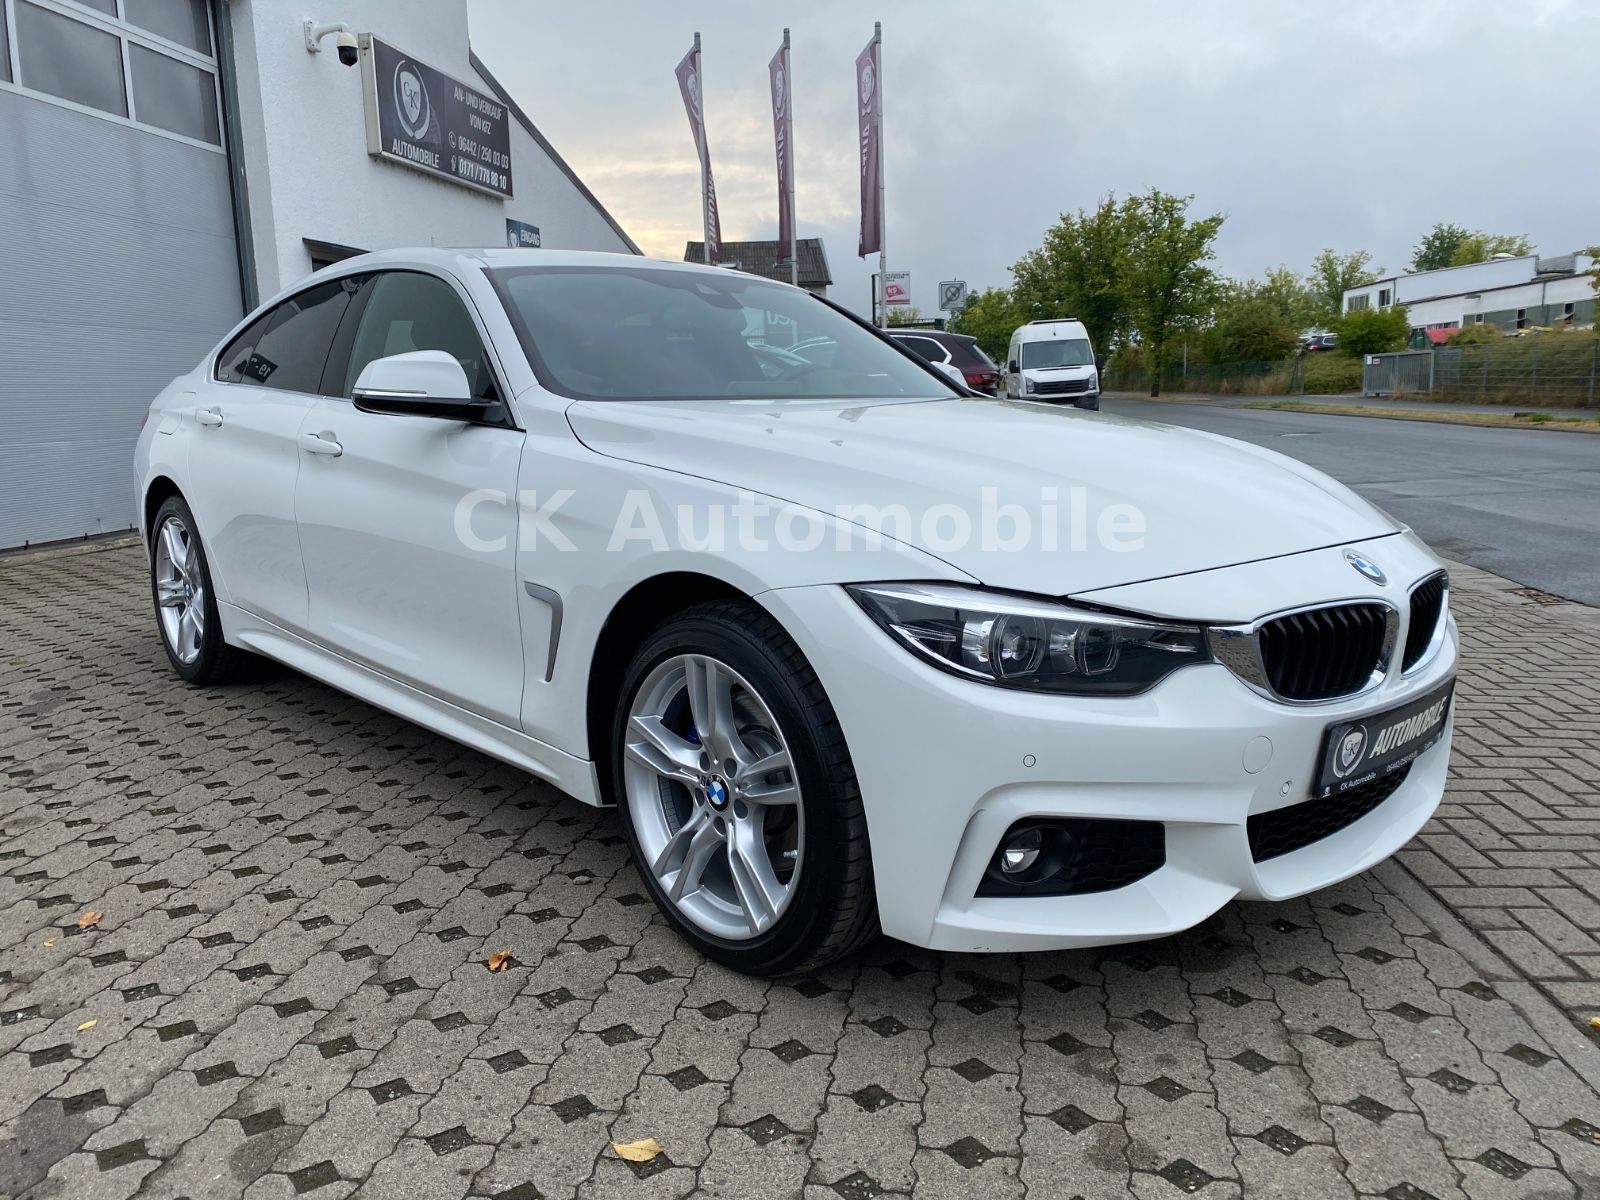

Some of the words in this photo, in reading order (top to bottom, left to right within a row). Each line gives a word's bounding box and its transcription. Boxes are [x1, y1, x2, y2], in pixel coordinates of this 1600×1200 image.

[465, 91, 478, 109] UND
[479, 98, 502, 121] VERKAUF
[469, 112, 481, 130] VON
[482, 120, 492, 135] KFZ
[392, 138, 440, 168] AUTOMOBILE
[458, 135, 477, 156] 06442
[459, 158, 474, 177] 0171
[500, 174, 507, 190] 10
[520, 229, 540, 246] EINGANG
[1368, 695, 1447, 759] AUTOMOBILE
[1348, 771, 1377, 788] Automobile
